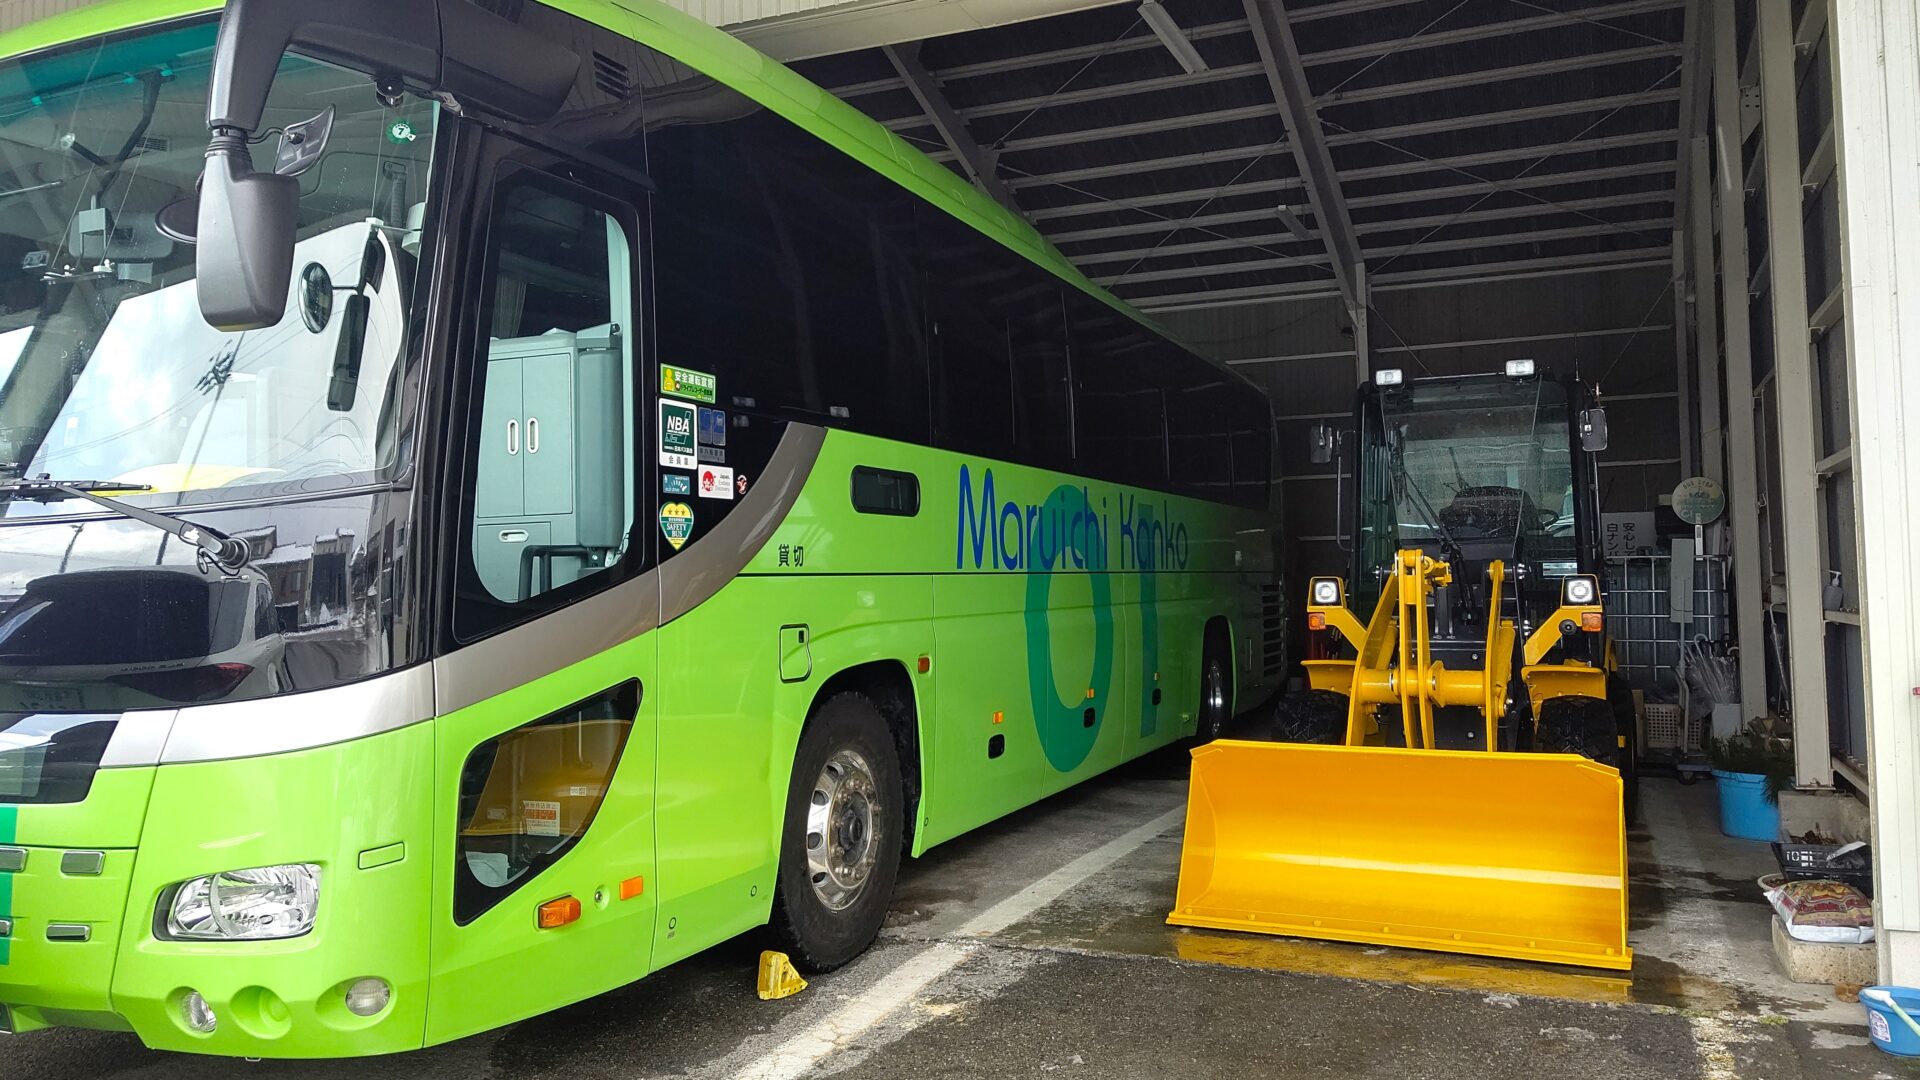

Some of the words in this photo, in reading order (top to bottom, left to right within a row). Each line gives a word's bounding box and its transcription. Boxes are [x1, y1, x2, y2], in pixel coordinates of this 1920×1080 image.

[668, 416, 689, 432] NBA
[956, 463, 1109, 570] Maruichi
[1119, 492, 1189, 570] Kanko
[666, 523, 687, 531] SAFETY
[671, 530, 683, 538] BUS
[778, 543, 804, 567] 貸切
